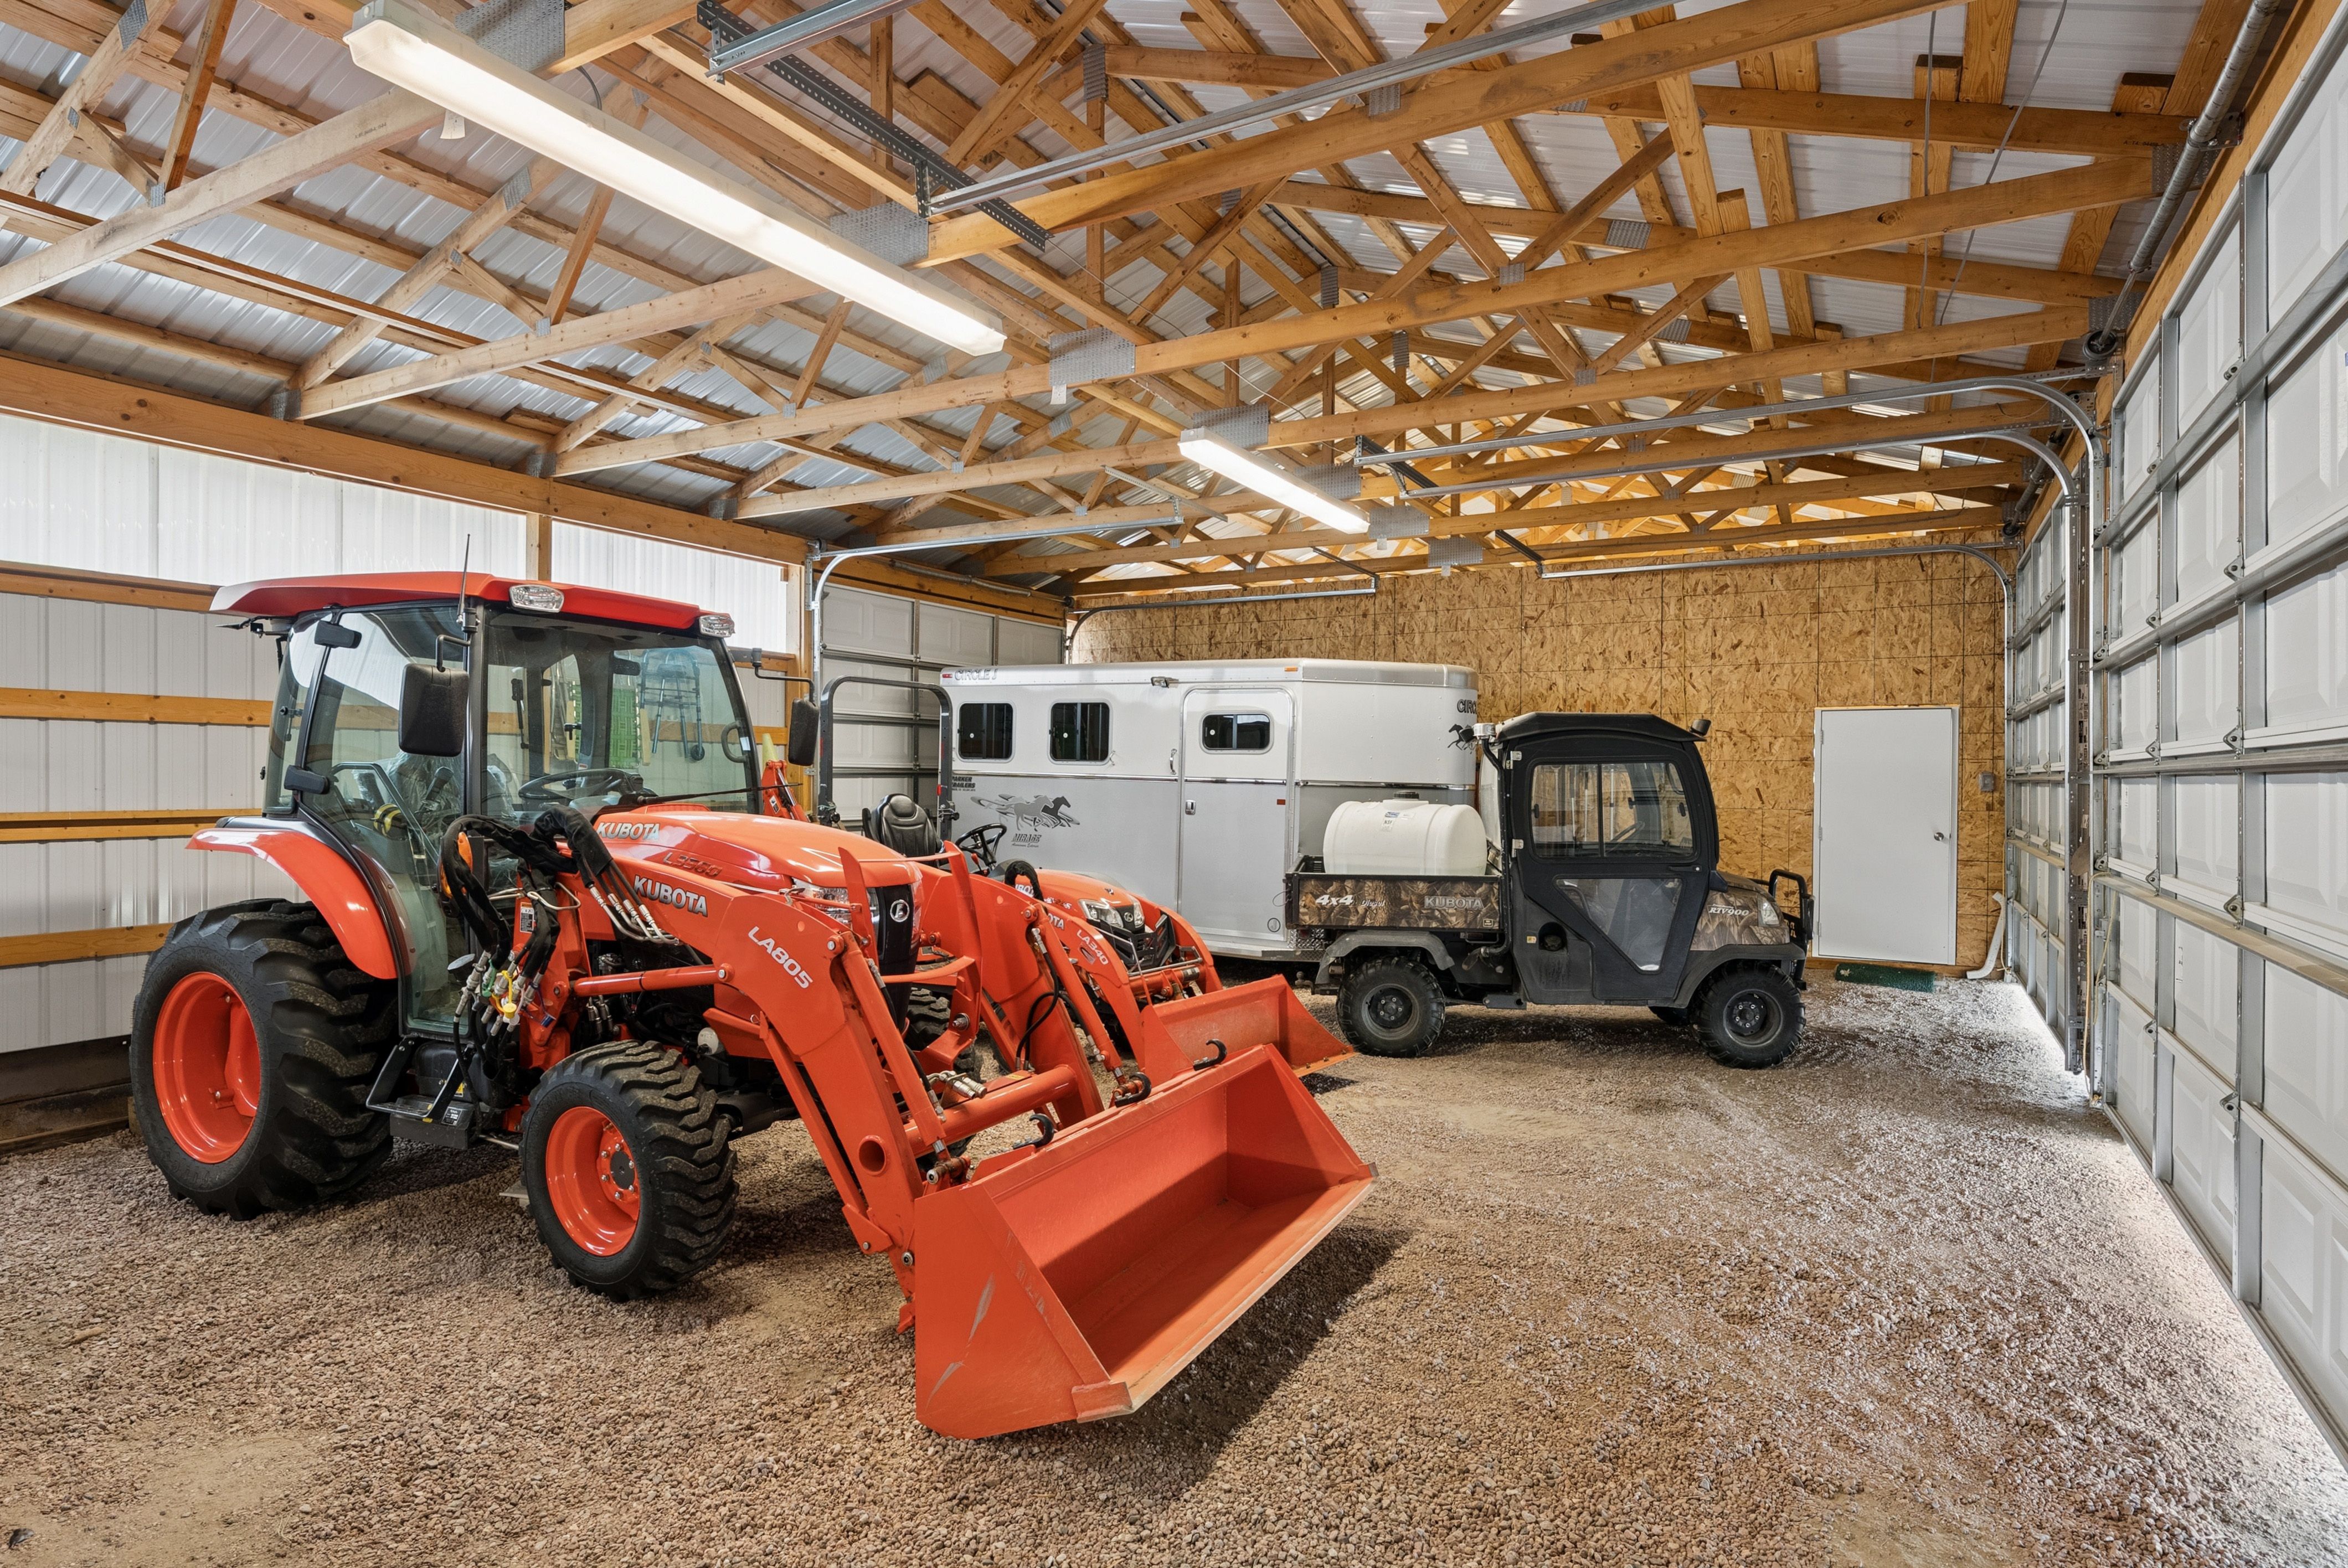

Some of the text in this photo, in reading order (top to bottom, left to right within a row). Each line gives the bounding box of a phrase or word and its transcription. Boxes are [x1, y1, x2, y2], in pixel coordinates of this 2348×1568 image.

[955, 668, 998, 680] CIRCLE J
[596, 822, 660, 840] KUBOTA
[634, 875, 708, 917] KUBOTA
[1316, 895, 1355, 906] 4x4
[1424, 896, 1485, 910] KUBOTA
[1708, 907, 1750, 916] RTV900
[1077, 930, 1109, 964] LA340
[748, 926, 813, 988] LA805
